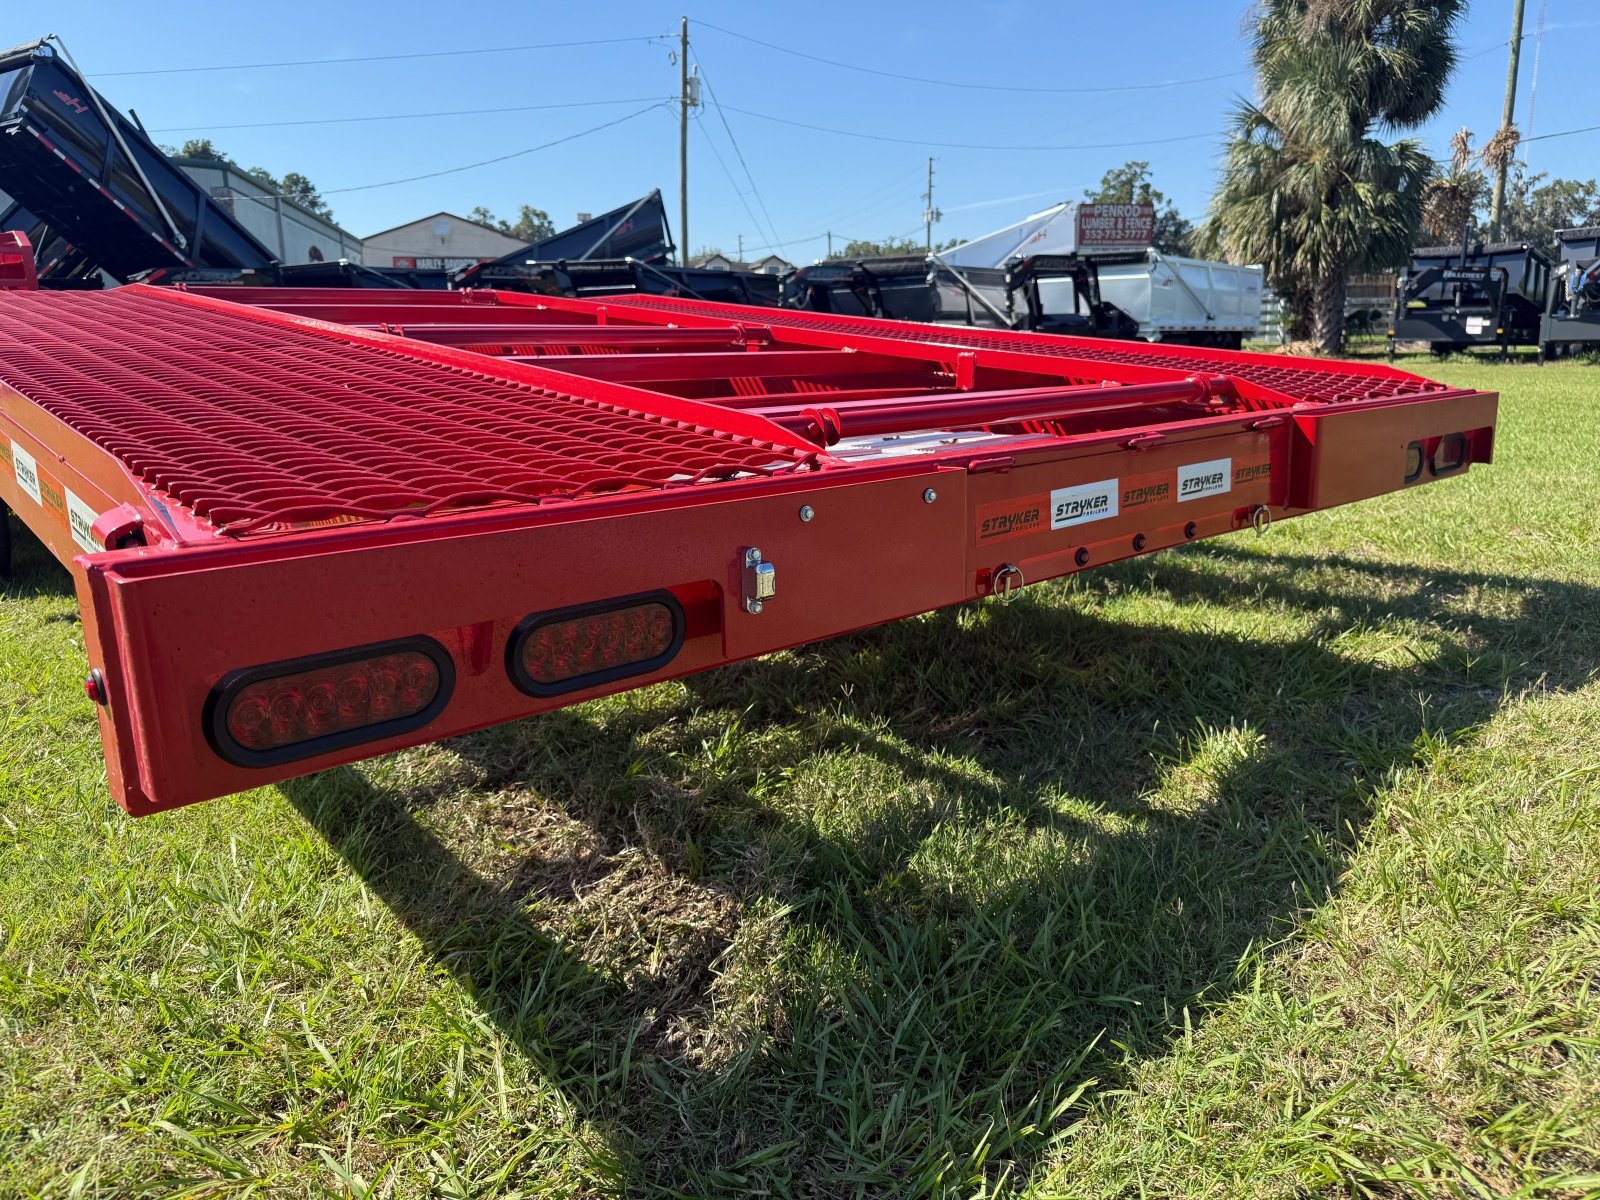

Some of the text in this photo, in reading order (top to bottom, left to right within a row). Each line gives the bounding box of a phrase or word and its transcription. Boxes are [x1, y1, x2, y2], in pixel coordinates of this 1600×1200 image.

[1081, 217, 1152, 229] LUMBER & FENCE
[1094, 205, 1141, 217] PENROD
[1181, 472, 1224, 496] STRYKER
[1234, 463, 1271, 485] STRYKER
[1121, 483, 1169, 508] STRYKER
[1054, 494, 1109, 522] STRYKER
[980, 508, 1040, 539] STRYKER
